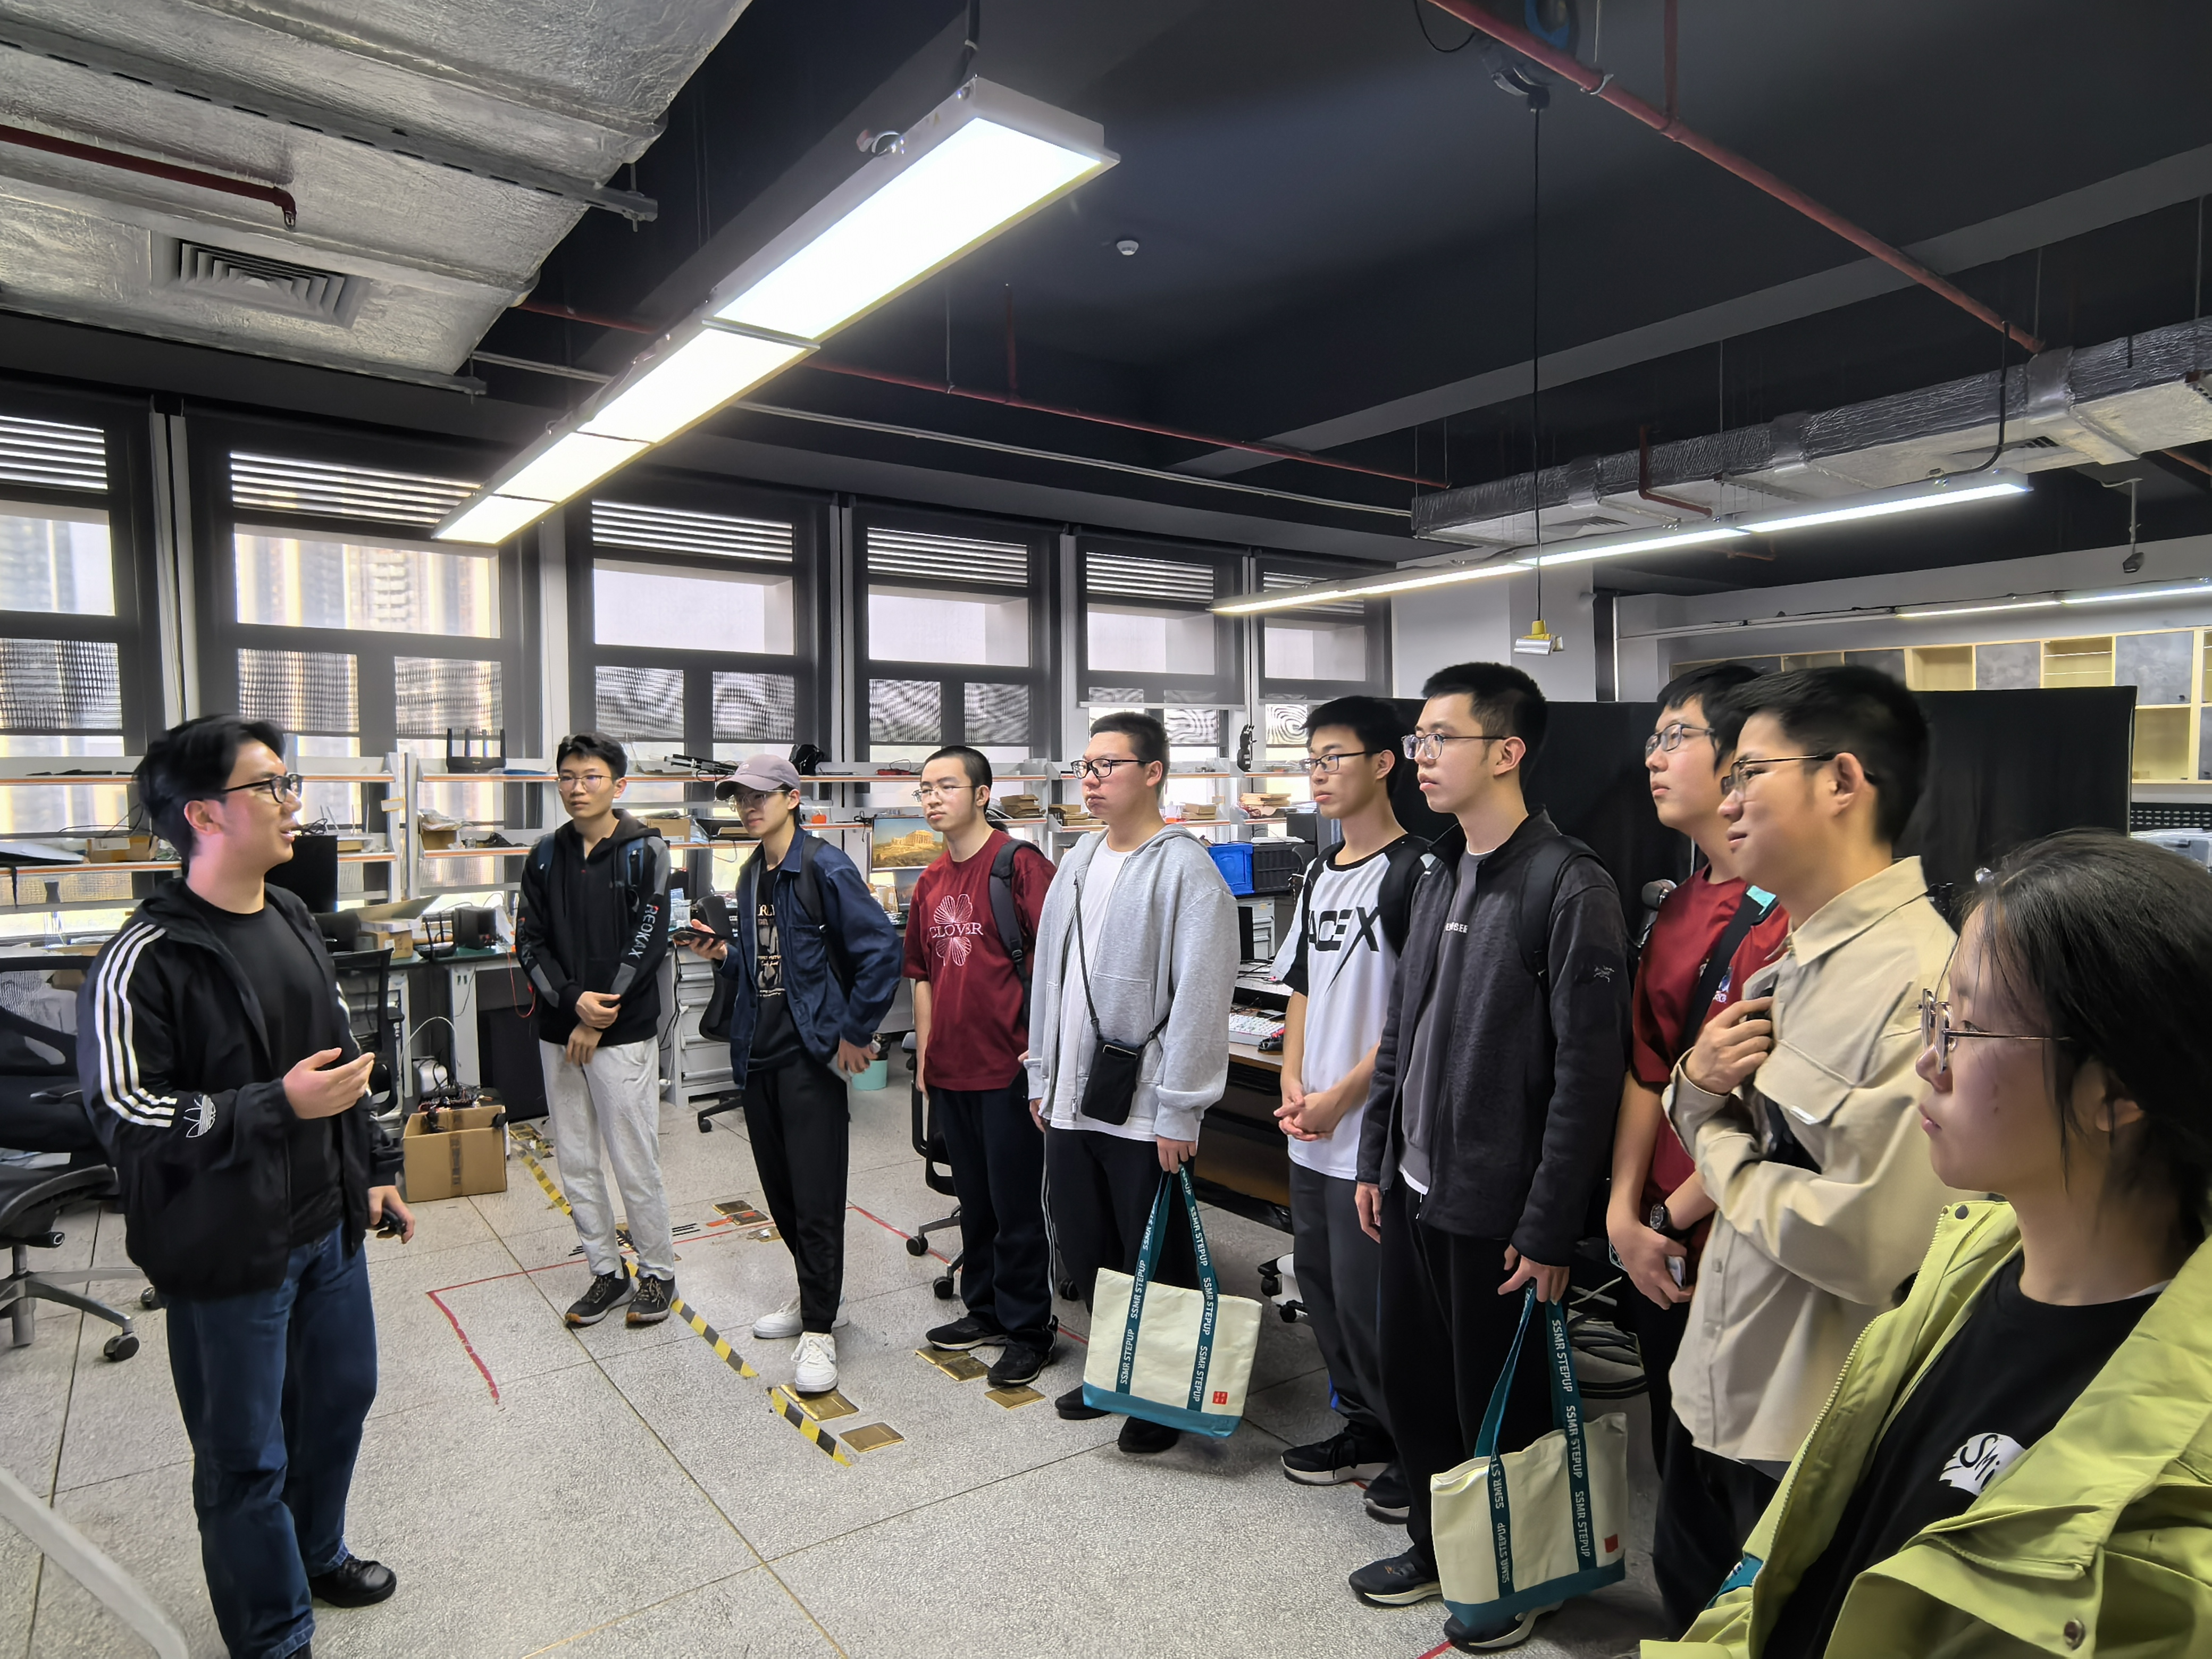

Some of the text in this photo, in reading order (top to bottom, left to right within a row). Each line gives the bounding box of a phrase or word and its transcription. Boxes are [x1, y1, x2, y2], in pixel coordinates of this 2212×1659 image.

[629, 904, 659, 959] REOKAX
[929, 922, 984, 938] CLOVER
[1196, 1232, 1208, 1267] STEPUP
[1130, 1260, 1146, 1319] SSMR STEPUP
[1203, 1277, 1213, 1336] SSMR STEPUP
[1120, 1329, 1135, 1385] SSMR STEPUP
[1193, 1345, 1208, 1402] SSMR STEPUP
[1552, 1319, 1573, 1393] SSMR STEPUP
[1566, 1405, 1583, 1479] SSMR STEPUP
[1493, 1478, 1504, 1509] SSMR
[1497, 1522, 1510, 1583] SSMR STEPUP
[1575, 1490, 1591, 1557] SSMR STEPUP
